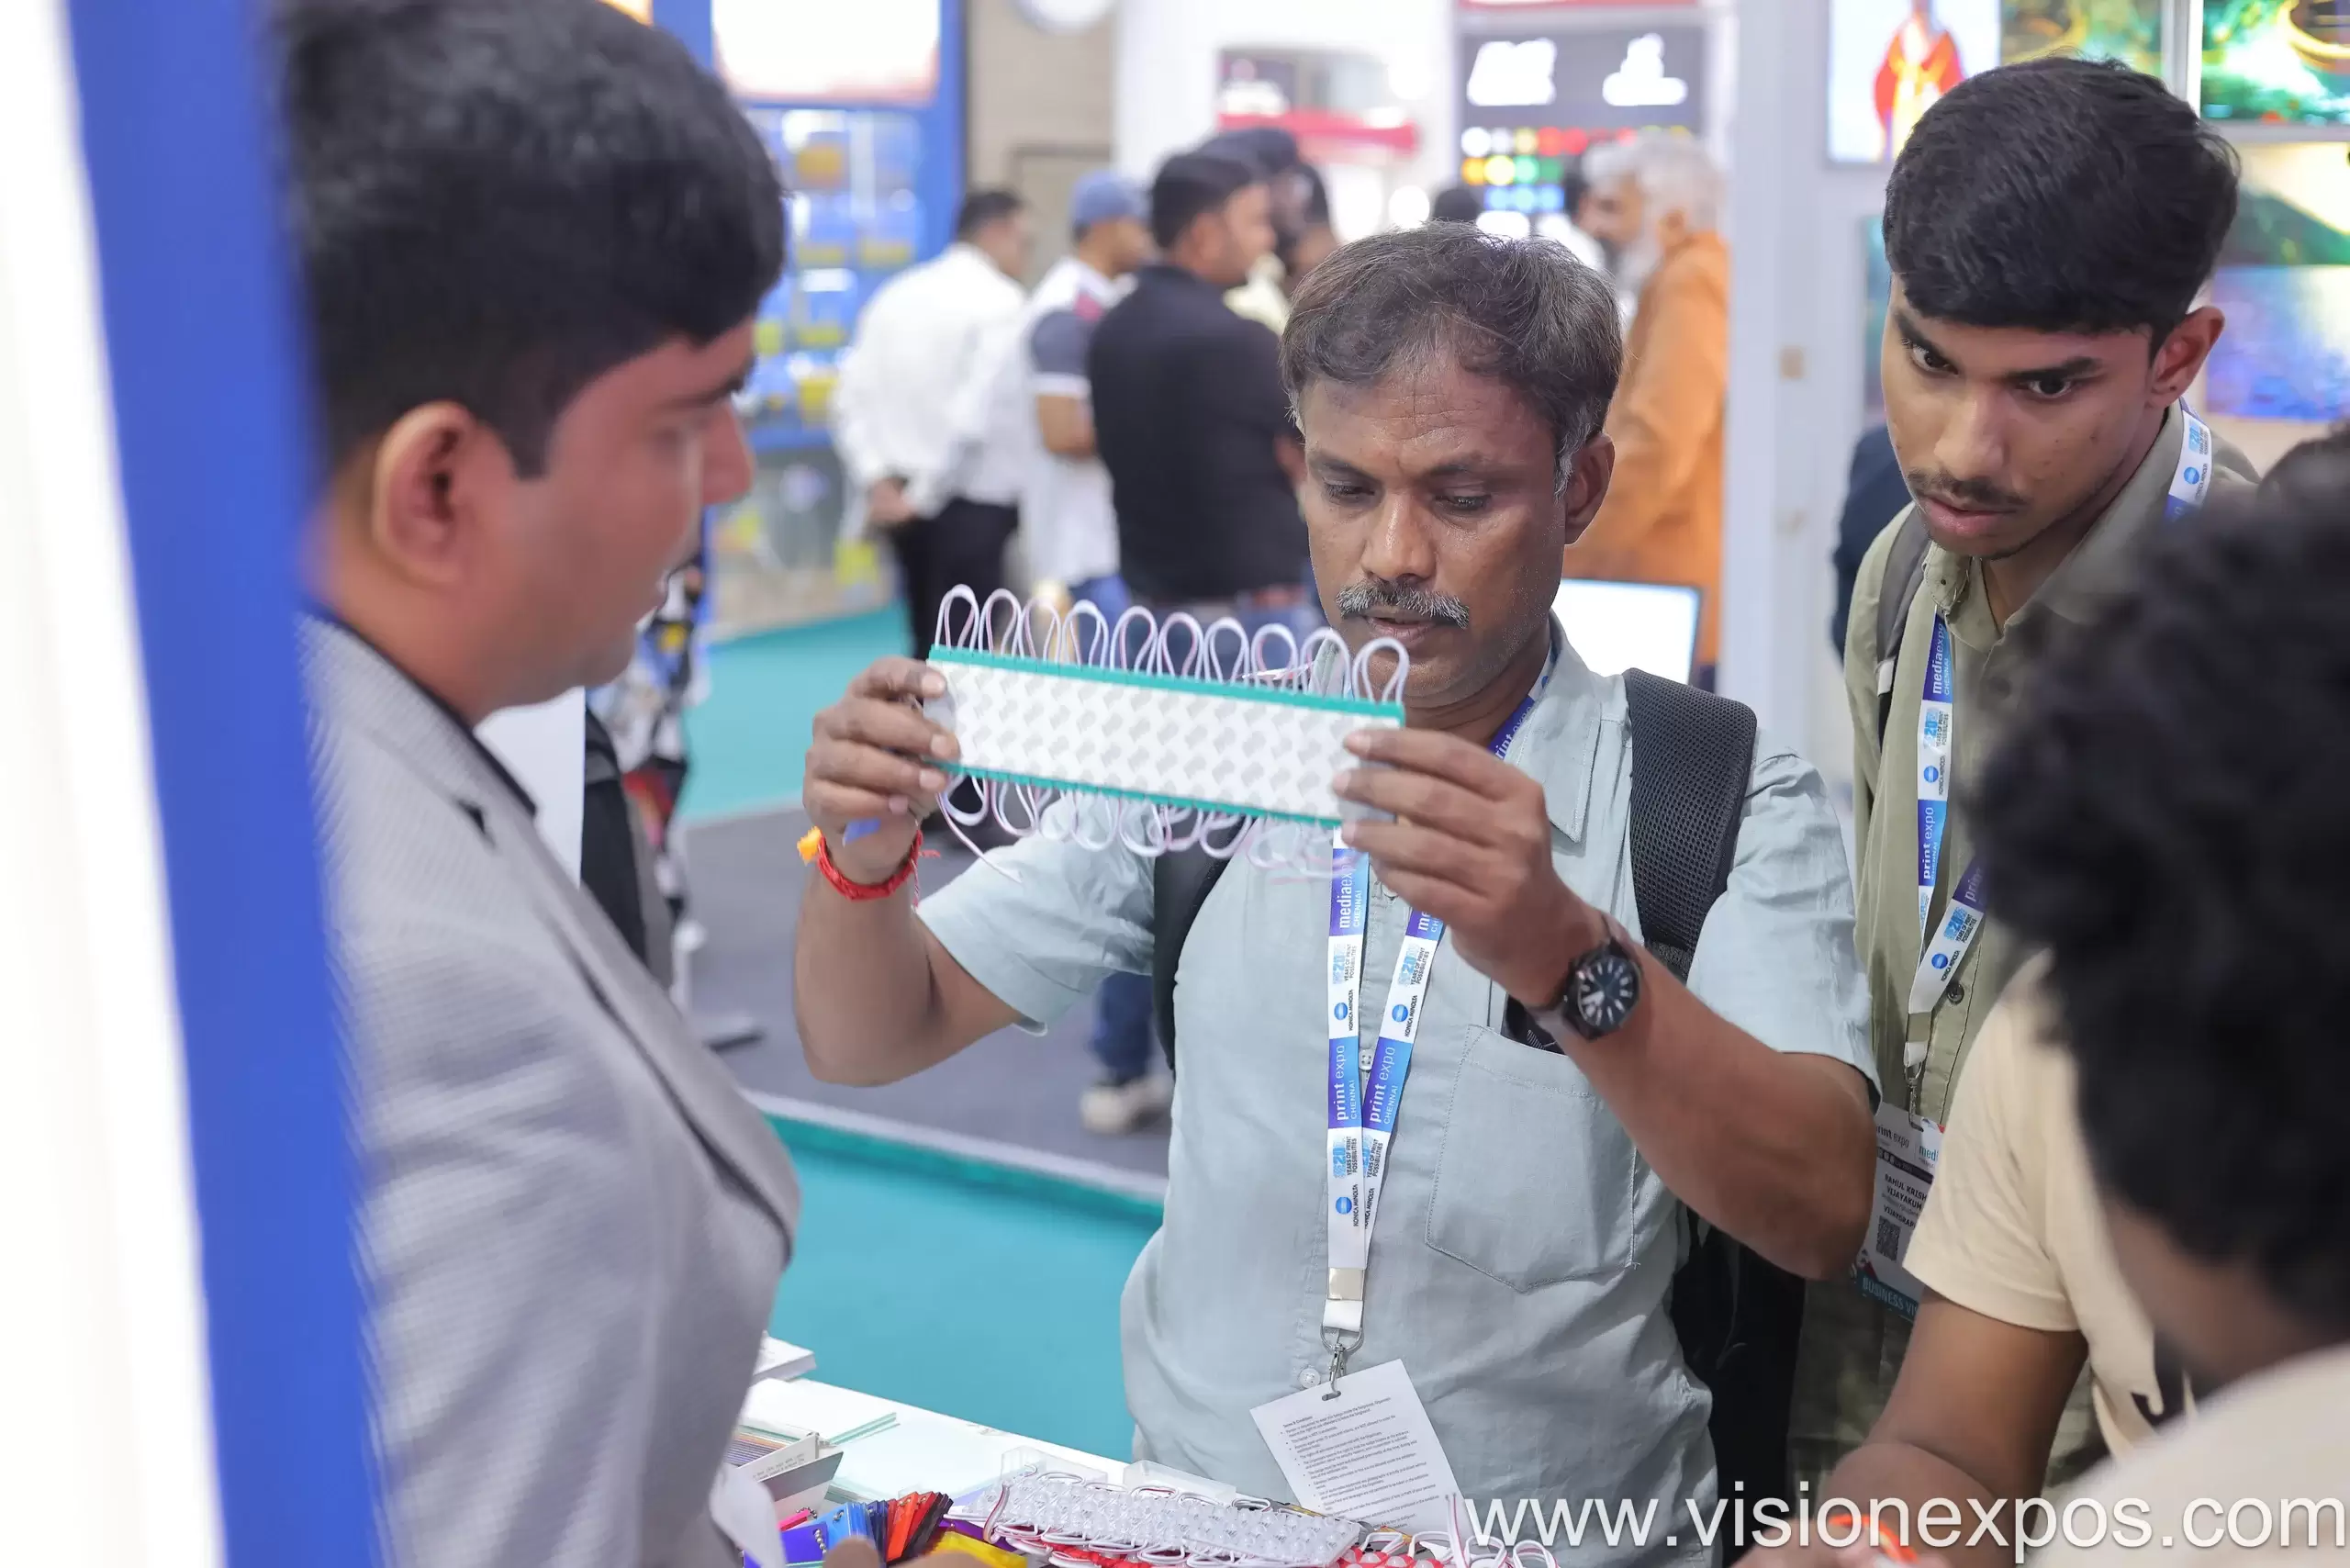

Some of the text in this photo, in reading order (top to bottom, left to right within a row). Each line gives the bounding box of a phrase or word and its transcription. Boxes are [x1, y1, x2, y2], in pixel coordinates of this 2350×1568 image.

[1931, 624, 1944, 694] mediaexpo
[1922, 807, 1935, 879] print expo
[1353, 890, 1362, 927] CHENNAI
[1416, 951, 1429, 984] POSSIBILITIES
[1404, 1016, 1413, 1037] KONICA
[1334, 1045, 1348, 1120] print expo
[1348, 1080, 1357, 1119] CHENNAI
[1370, 1047, 1395, 1123] print expo
[1384, 1085, 1397, 1124] CHENNAI
[1876, 1126, 1909, 1148] rint expo
[1371, 1142, 1382, 1177] POSSIBILITIES
[1367, 1188, 1375, 1210] MINOLTA
[1886, 1173, 1904, 1190] RAHUL
[1863, 1277, 1904, 1310] BUSINESS
